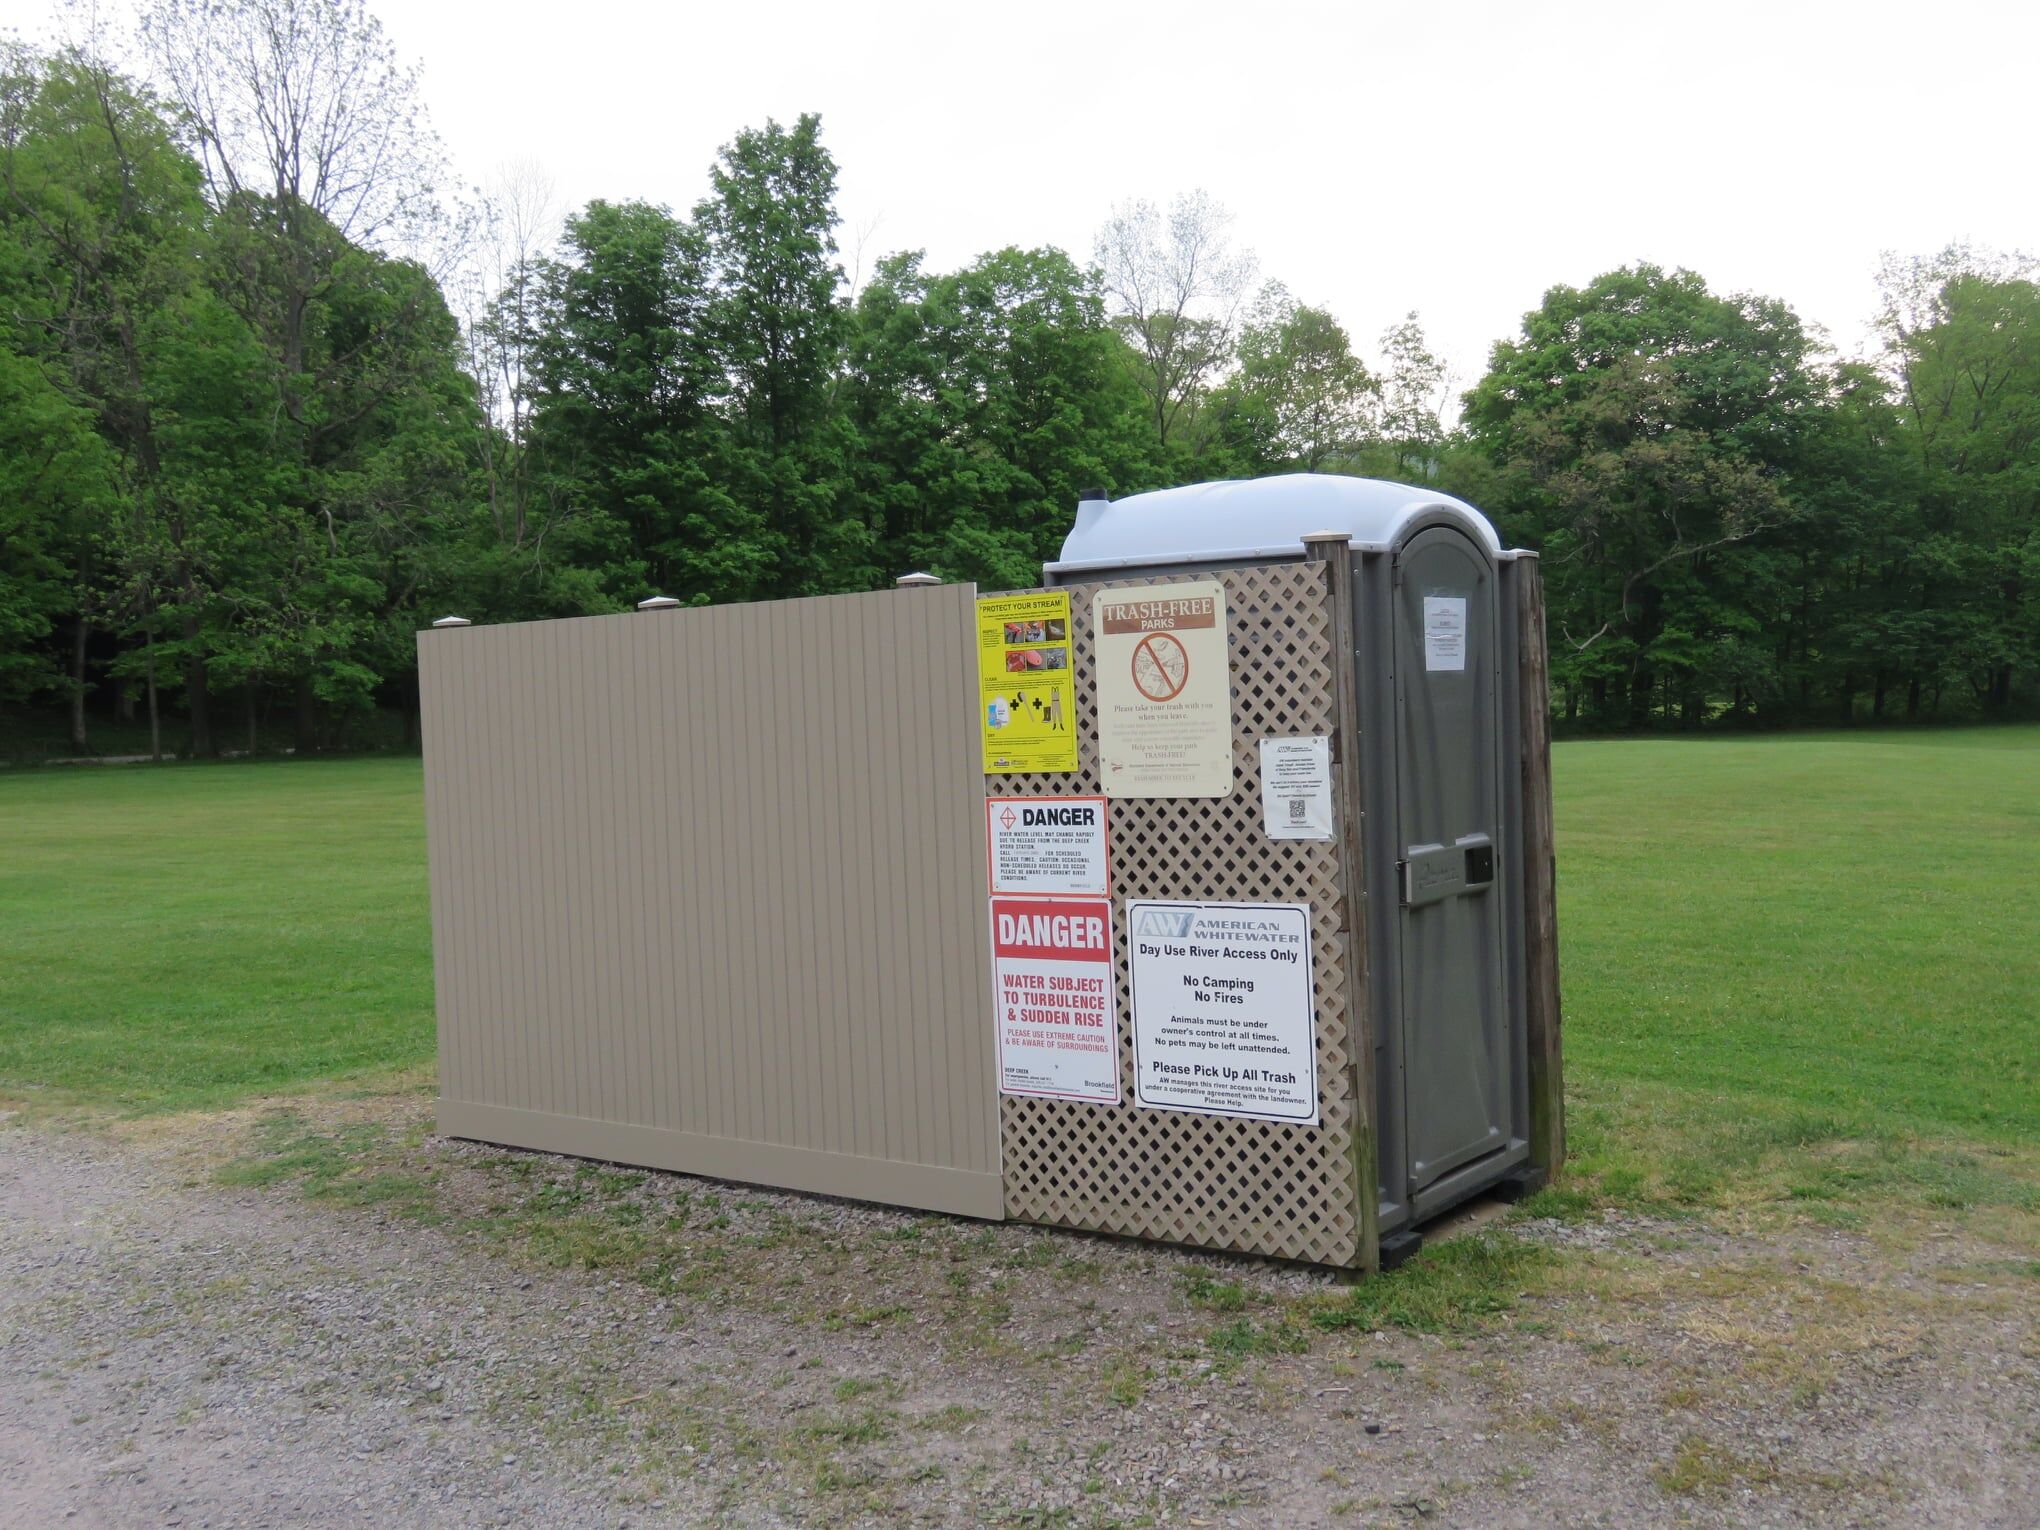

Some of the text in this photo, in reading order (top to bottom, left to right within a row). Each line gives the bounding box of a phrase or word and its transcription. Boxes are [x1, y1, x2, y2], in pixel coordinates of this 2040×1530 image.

[983, 604, 1011, 612] PROTECT
[1033, 600, 1062, 608] STREAM!
[1104, 599, 1211, 620] TRASH-FREE
[1141, 619, 1174, 630] PARKS
[1150, 705, 1165, 713] your
[1157, 714, 1168, 722] you
[1170, 712, 1188, 720] leave.
[1022, 808, 1095, 826] DANGER
[998, 914, 1104, 949] DANGER
[1195, 920, 1280, 931] AMERICAN
[1194, 931, 1299, 943] WHITEWATER
[1140, 944, 1298, 963] Day Use River Access Only
[1003, 974, 1104, 992] WATER SUBJECT
[1183, 975, 1254, 992] No Camping
[1004, 991, 1105, 1010] TO TURBULENCE
[1195, 991, 1244, 1004] No Fires
[1008, 1008, 1103, 1027] & SUDDEN RISE
[1171, 1015, 1268, 1029] Animals must be under
[1008, 1029, 1105, 1043] PLEASE USE EXTREME CAUTION
[1161, 1027, 1279, 1042] owner's control at all times.
[1022, 1039, 1045, 1048] AWARE
[1057, 1042, 1109, 1053] SURROUNDINGS
[1155, 1037, 1290, 1054] No pets may be left unattended.
[1153, 1061, 1296, 1084] Please Pick Up All Trash
[1085, 1080, 1114, 1089] Brookfield
[1171, 1079, 1199, 1087] manages
[1200, 1080, 1212, 1088] this
[1254, 1084, 1266, 1093] site
[1268, 1086, 1277, 1094] for
[1169, 1086, 1206, 1095] cooperative
[1207, 1090, 1241, 1099] agreement
[1242, 1092, 1257, 1100] with
[1258, 1093, 1269, 1101] the
[1271, 1095, 1307, 1105] landowner.
[1204, 1097, 1244, 1107] Please Help.
